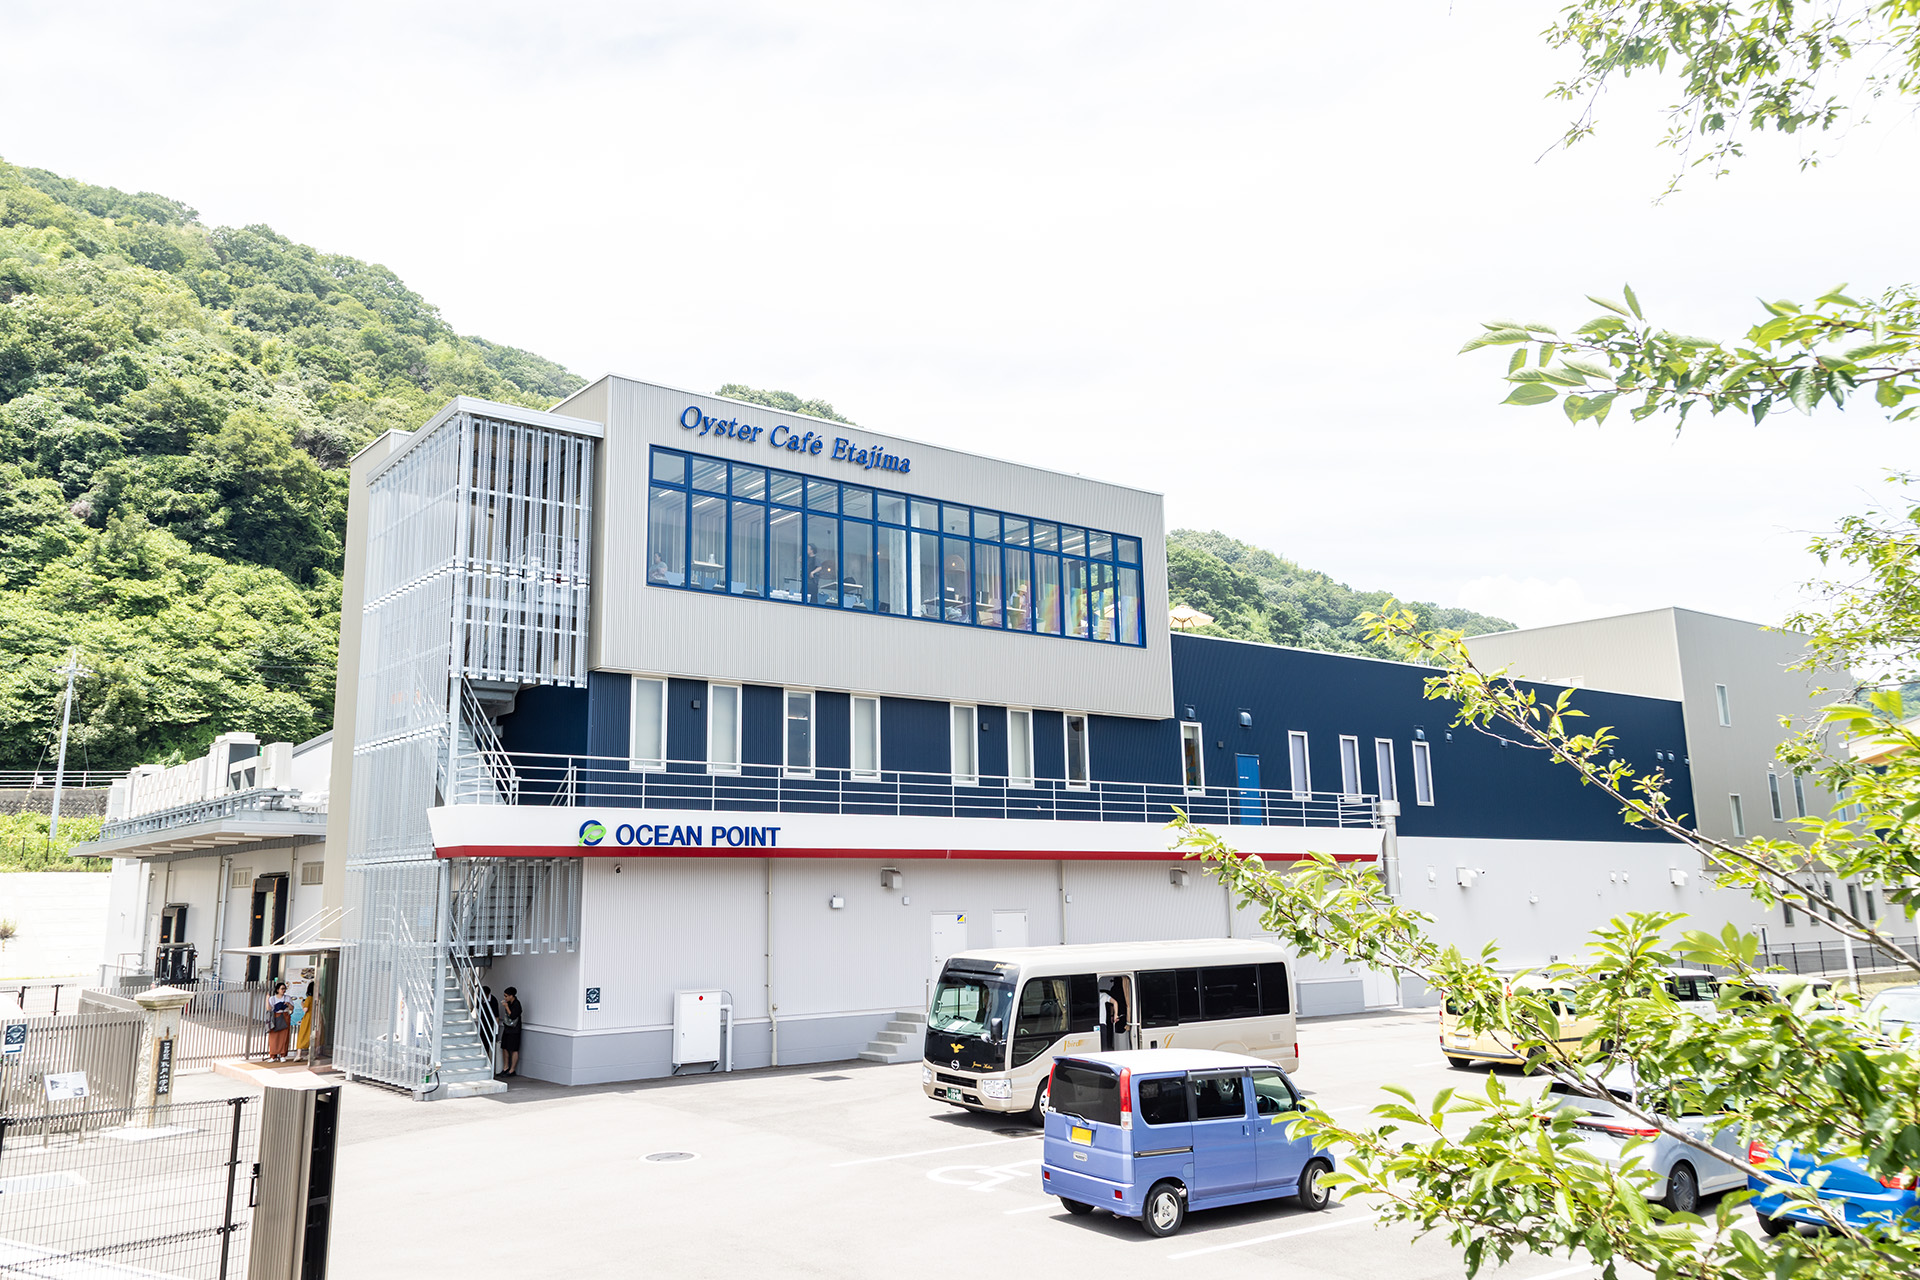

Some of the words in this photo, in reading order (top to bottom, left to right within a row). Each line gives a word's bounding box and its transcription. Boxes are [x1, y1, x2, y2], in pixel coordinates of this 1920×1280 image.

[680, 405, 763, 443] Oyster
[769, 425, 824, 456] Café
[831, 437, 912, 474] Etajima
[615, 823, 702, 846] OCEAN
[711, 826, 781, 847] POINT
